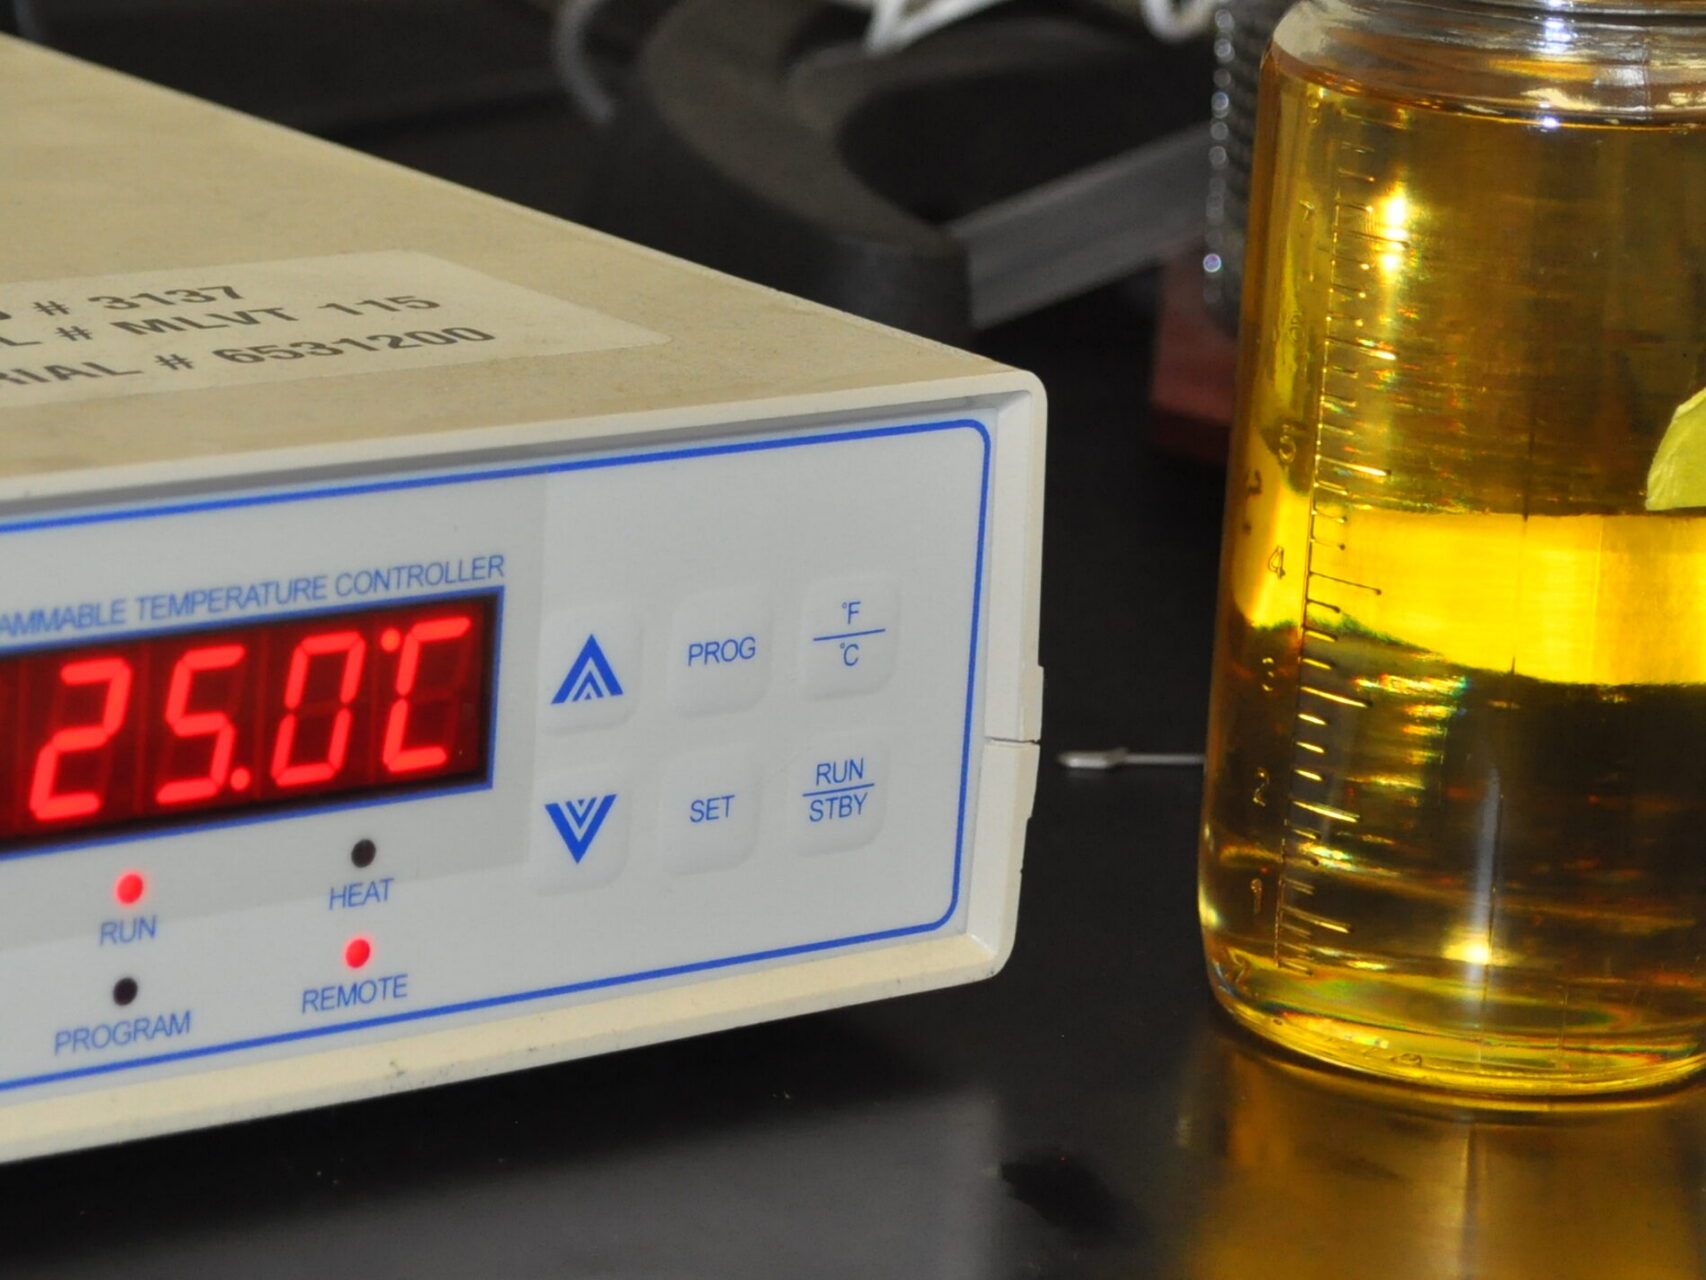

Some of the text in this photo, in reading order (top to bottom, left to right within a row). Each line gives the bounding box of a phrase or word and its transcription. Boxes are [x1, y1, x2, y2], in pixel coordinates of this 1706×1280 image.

[33, 300, 70, 316] #
[87, 285, 244, 310] 3137
[55, 325, 93, 341] #
[109, 307, 299, 335] MLVT
[317, 295, 441, 316] 115
[154, 353, 195, 370] #
[211, 327, 496, 363] 6531200
[135, 573, 330, 623] TEMPERATURE
[335, 554, 505, 596] CONTROLLER
[687, 636, 757, 667] PROG
[814, 757, 865, 785] RUN
[689, 794, 736, 824] SET
[808, 791, 870, 824] STBY
[328, 877, 396, 911] HEAT
[99, 914, 158, 947] RUN
[301, 973, 409, 1014] REMOTE
[53, 1010, 192, 1057] PROGRAM
